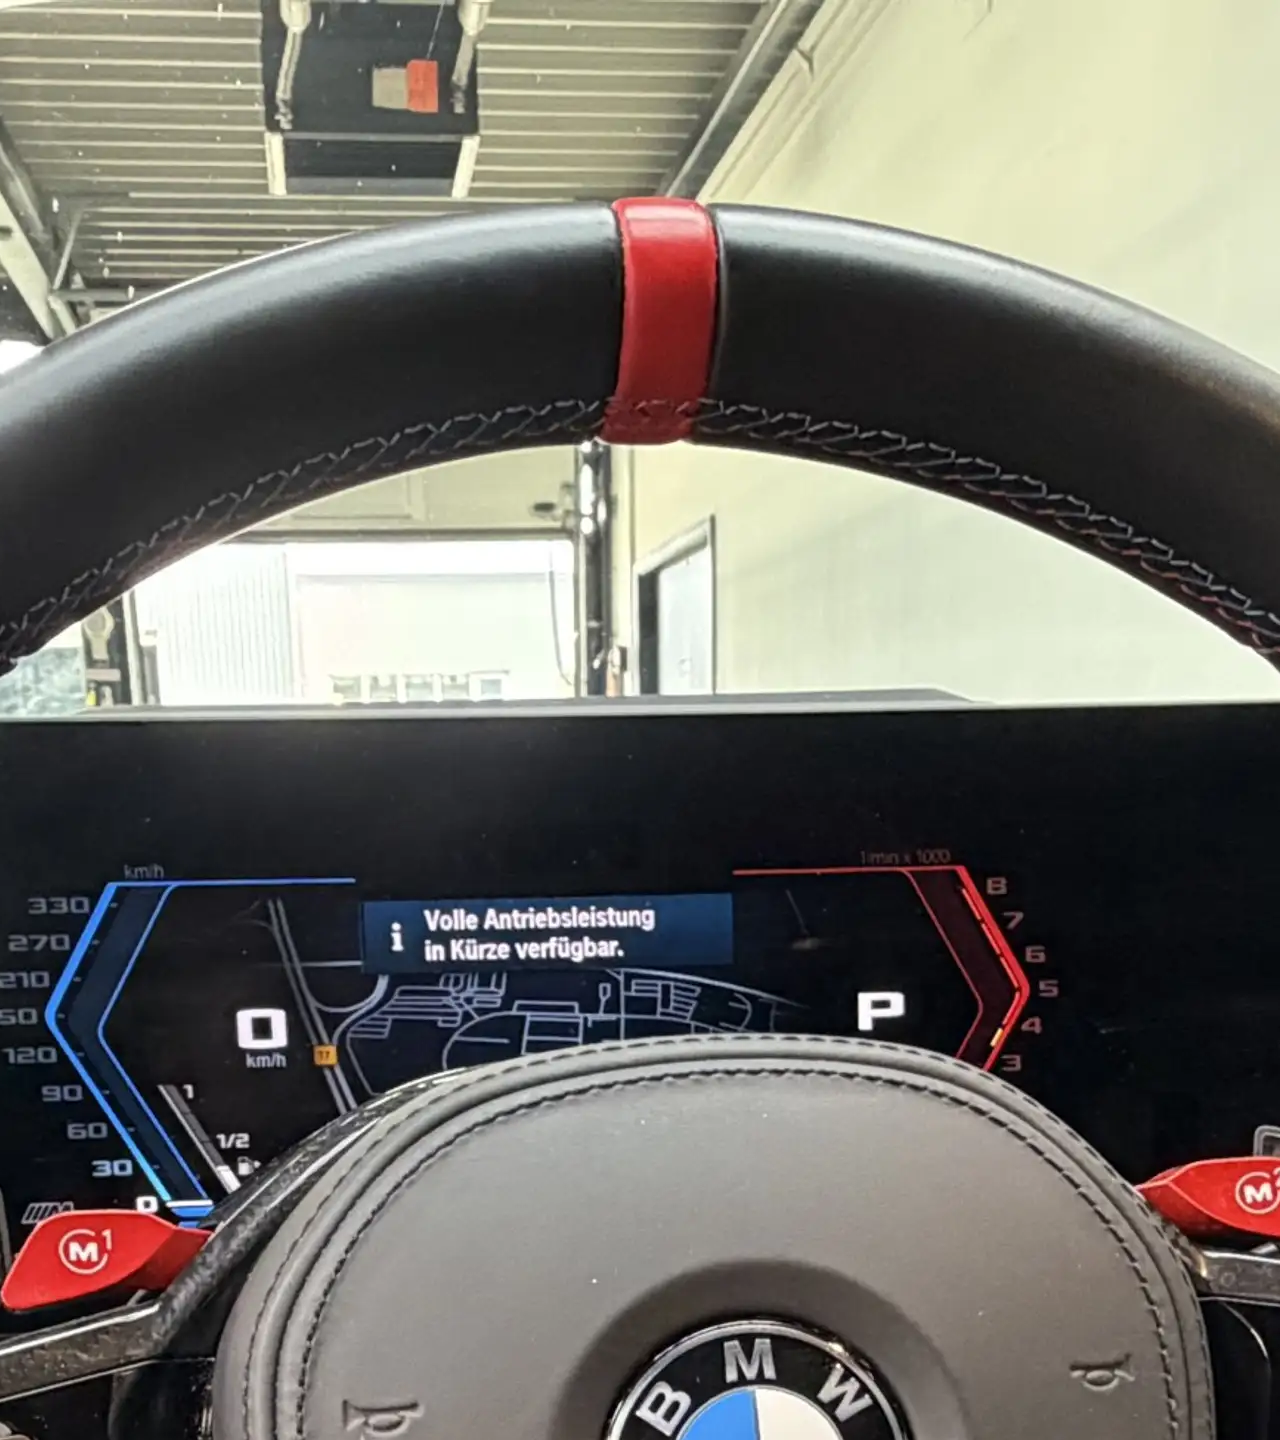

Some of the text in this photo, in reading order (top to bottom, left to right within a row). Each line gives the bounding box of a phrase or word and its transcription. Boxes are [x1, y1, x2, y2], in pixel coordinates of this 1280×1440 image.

[123, 863, 165, 880] km/h
[27, 896, 91, 915] 330
[423, 905, 656, 932] Volle Antriebsleistung
[1002, 910, 1025, 931] 7
[7, 933, 70, 952] 270
[424, 936, 625, 963] in Kürze verfügbar.
[1025, 944, 1046, 964] 6
[1038, 979, 1059, 998] 5
[857, 990, 906, 1031] P
[236, 1008, 288, 1050] 0
[1020, 1015, 1043, 1035] 4
[1, 1046, 58, 1065] 120
[245, 1051, 287, 1069] km/h
[1000, 1054, 1022, 1072] 3
[40, 1084, 84, 1102] 90
[182, 1083, 195, 1100] 1
[66, 1121, 108, 1140] 60
[215, 1132, 251, 1149] 1/2
[90, 1159, 133, 1178] 30
[135, 1195, 159, 1213] 0
[634, 1336, 872, 1437] BMW
